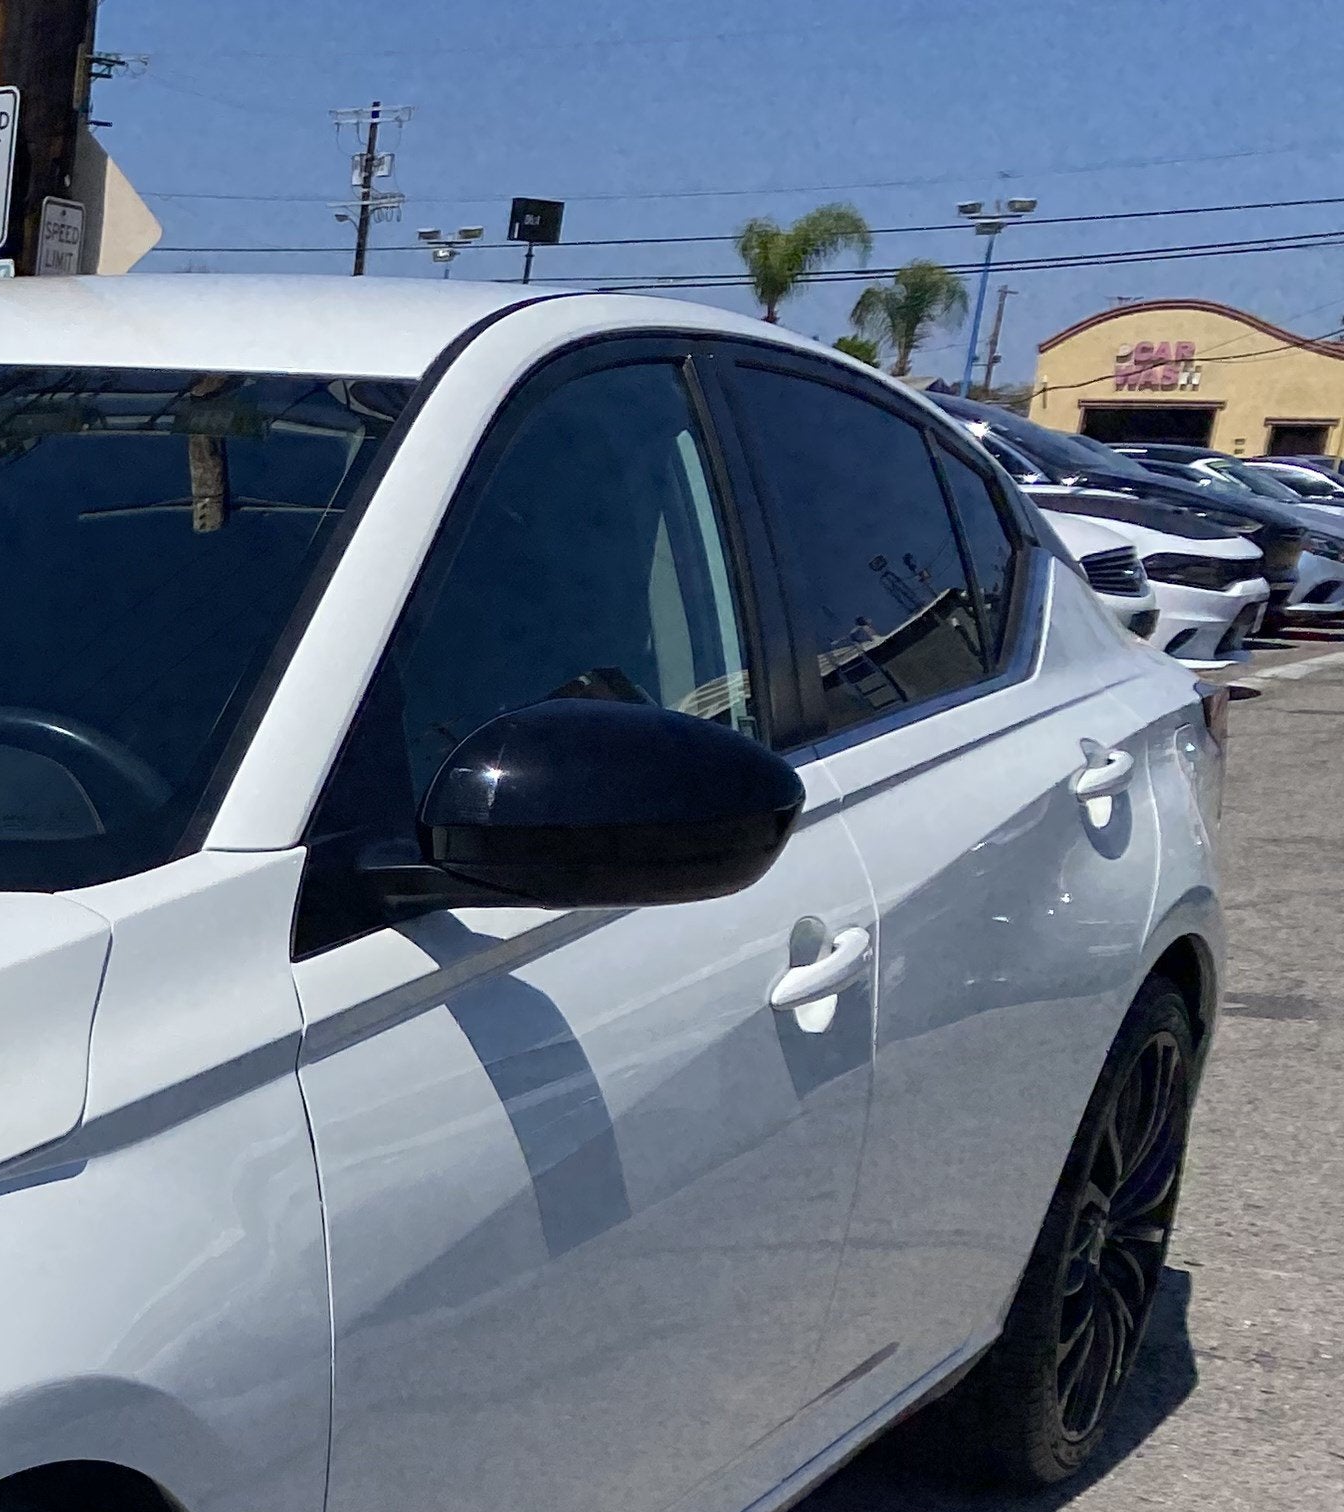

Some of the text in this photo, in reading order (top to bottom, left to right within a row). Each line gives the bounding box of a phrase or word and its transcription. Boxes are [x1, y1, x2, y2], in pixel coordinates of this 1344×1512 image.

[45, 221, 80, 245] SPEED
[44, 250, 74, 270] LIMIT
[1133, 341, 1196, 365] CAR
[1115, 363, 1202, 391] WASH
